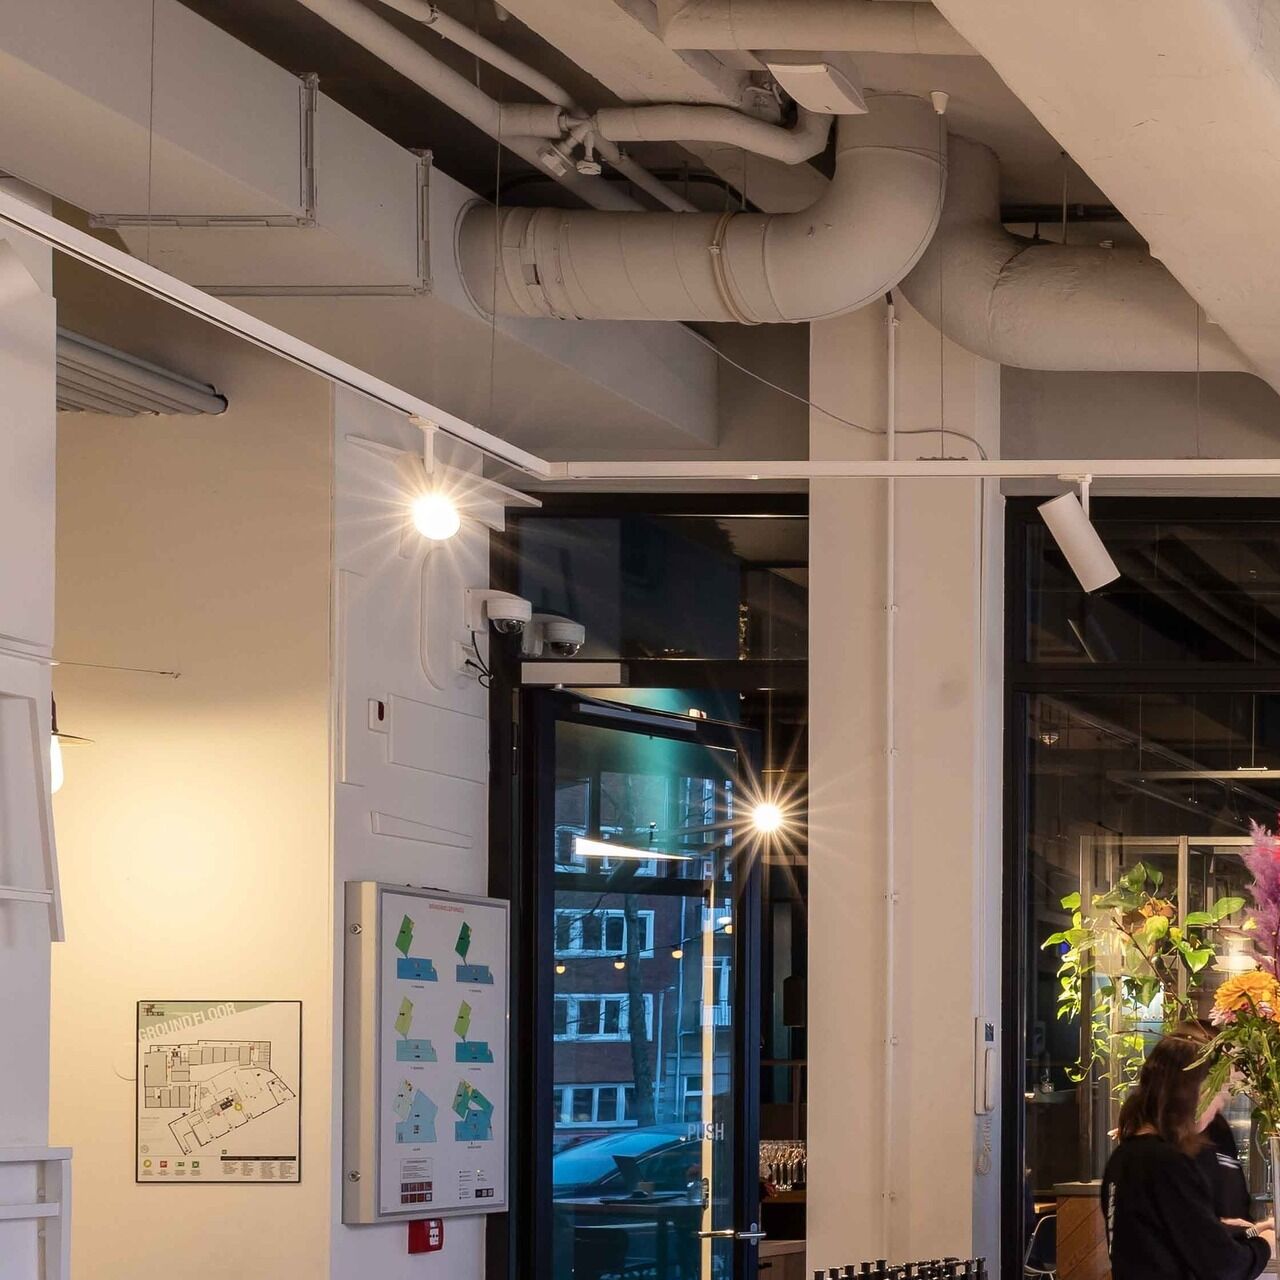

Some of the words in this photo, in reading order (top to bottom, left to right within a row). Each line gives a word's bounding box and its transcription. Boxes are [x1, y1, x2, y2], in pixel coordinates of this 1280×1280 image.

[138, 1014, 193, 1042] GROUND
[192, 1001, 237, 1024] FLOOR
[686, 1122, 725, 1141] PUSH
